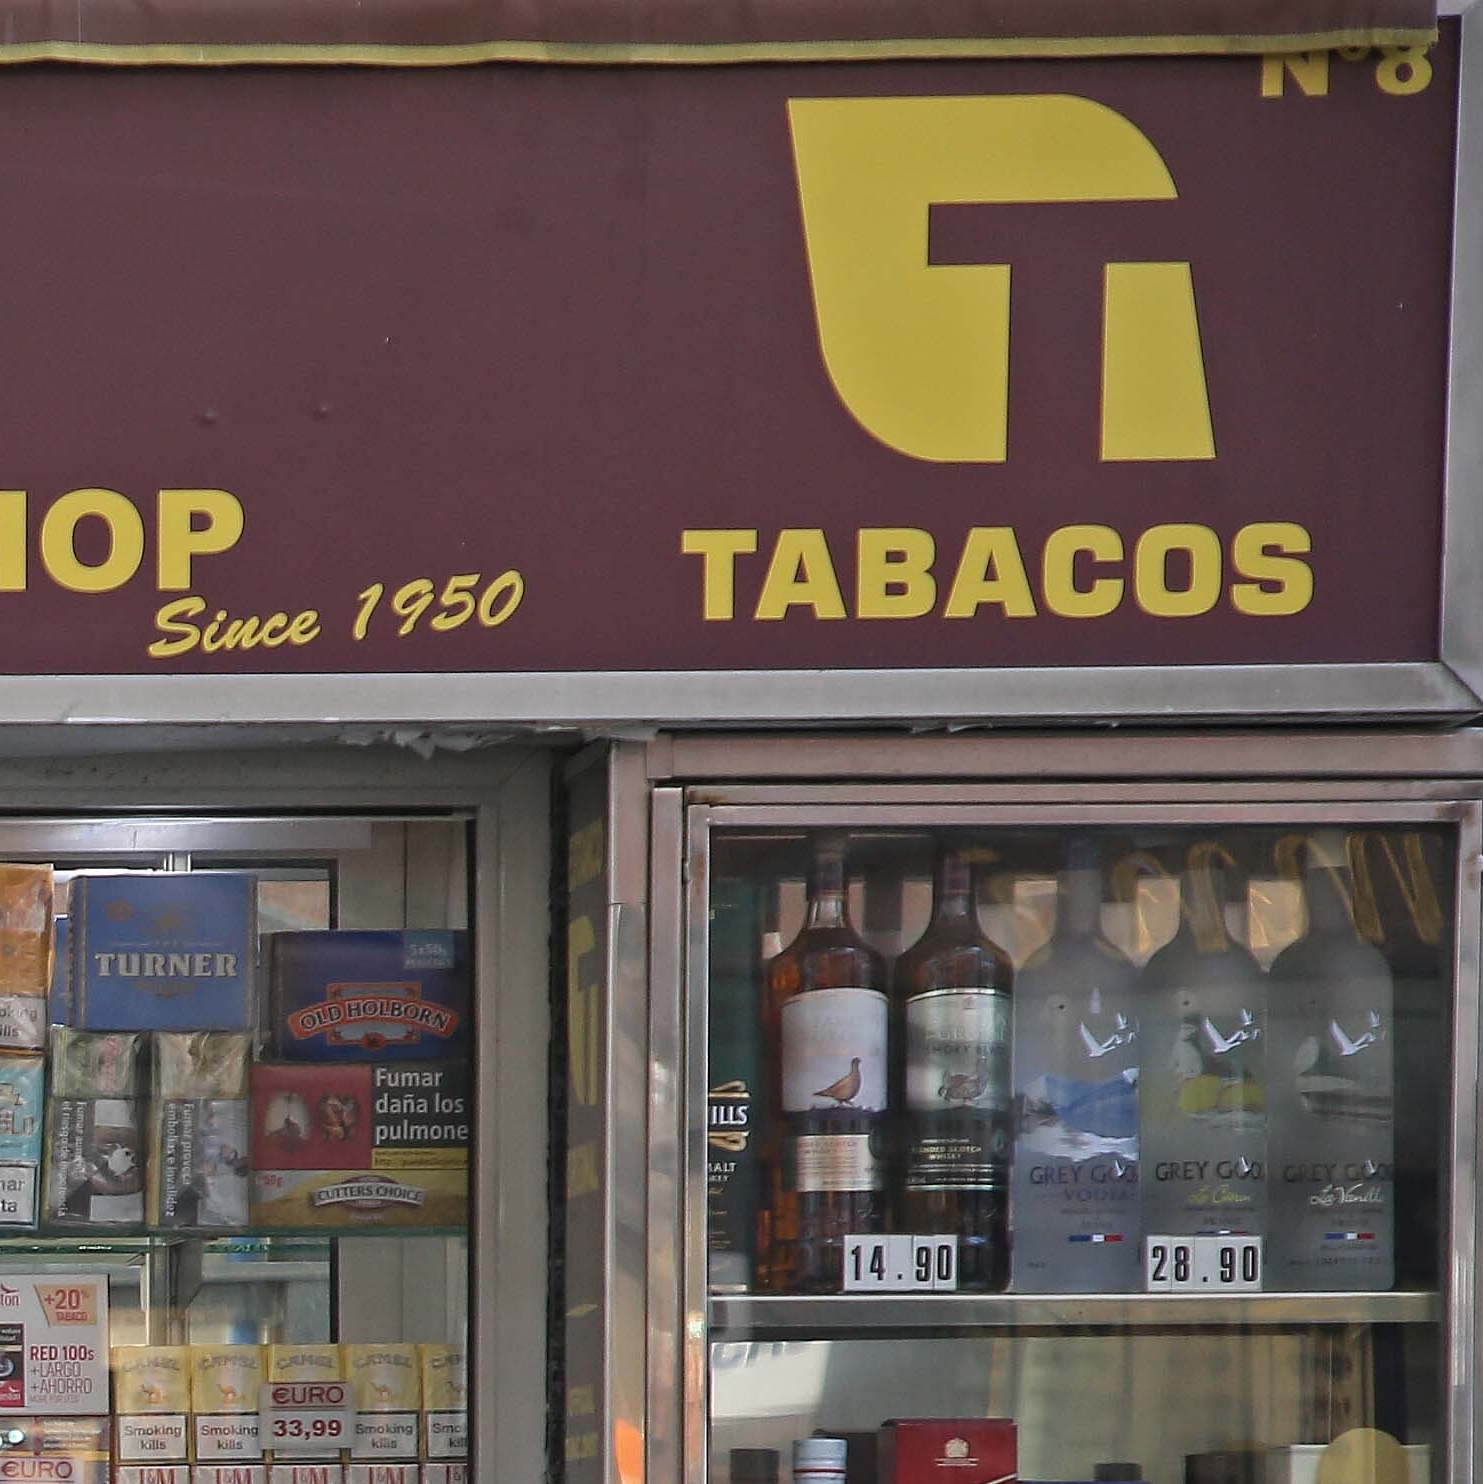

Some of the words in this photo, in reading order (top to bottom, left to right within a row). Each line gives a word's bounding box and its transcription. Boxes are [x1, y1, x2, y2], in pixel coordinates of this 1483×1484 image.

[682, 522, 1315, 621] TABACOS
[149, 597, 321, 660] Since
[351, 570, 525, 641] 1950
[95, 952, 238, 979] TURNER
[299, 1006, 343, 1033] OLD
[346, 999, 451, 1031] HOLBORN
[375, 1067, 444, 1089] Fumar
[375, 1092, 428, 1115] daña
[434, 1092, 465, 1115] los
[850, 1243, 954, 1282] 14.90
[1152, 1243, 1259, 1283] 28.90
[273, 1419, 343, 1439] 33,99
